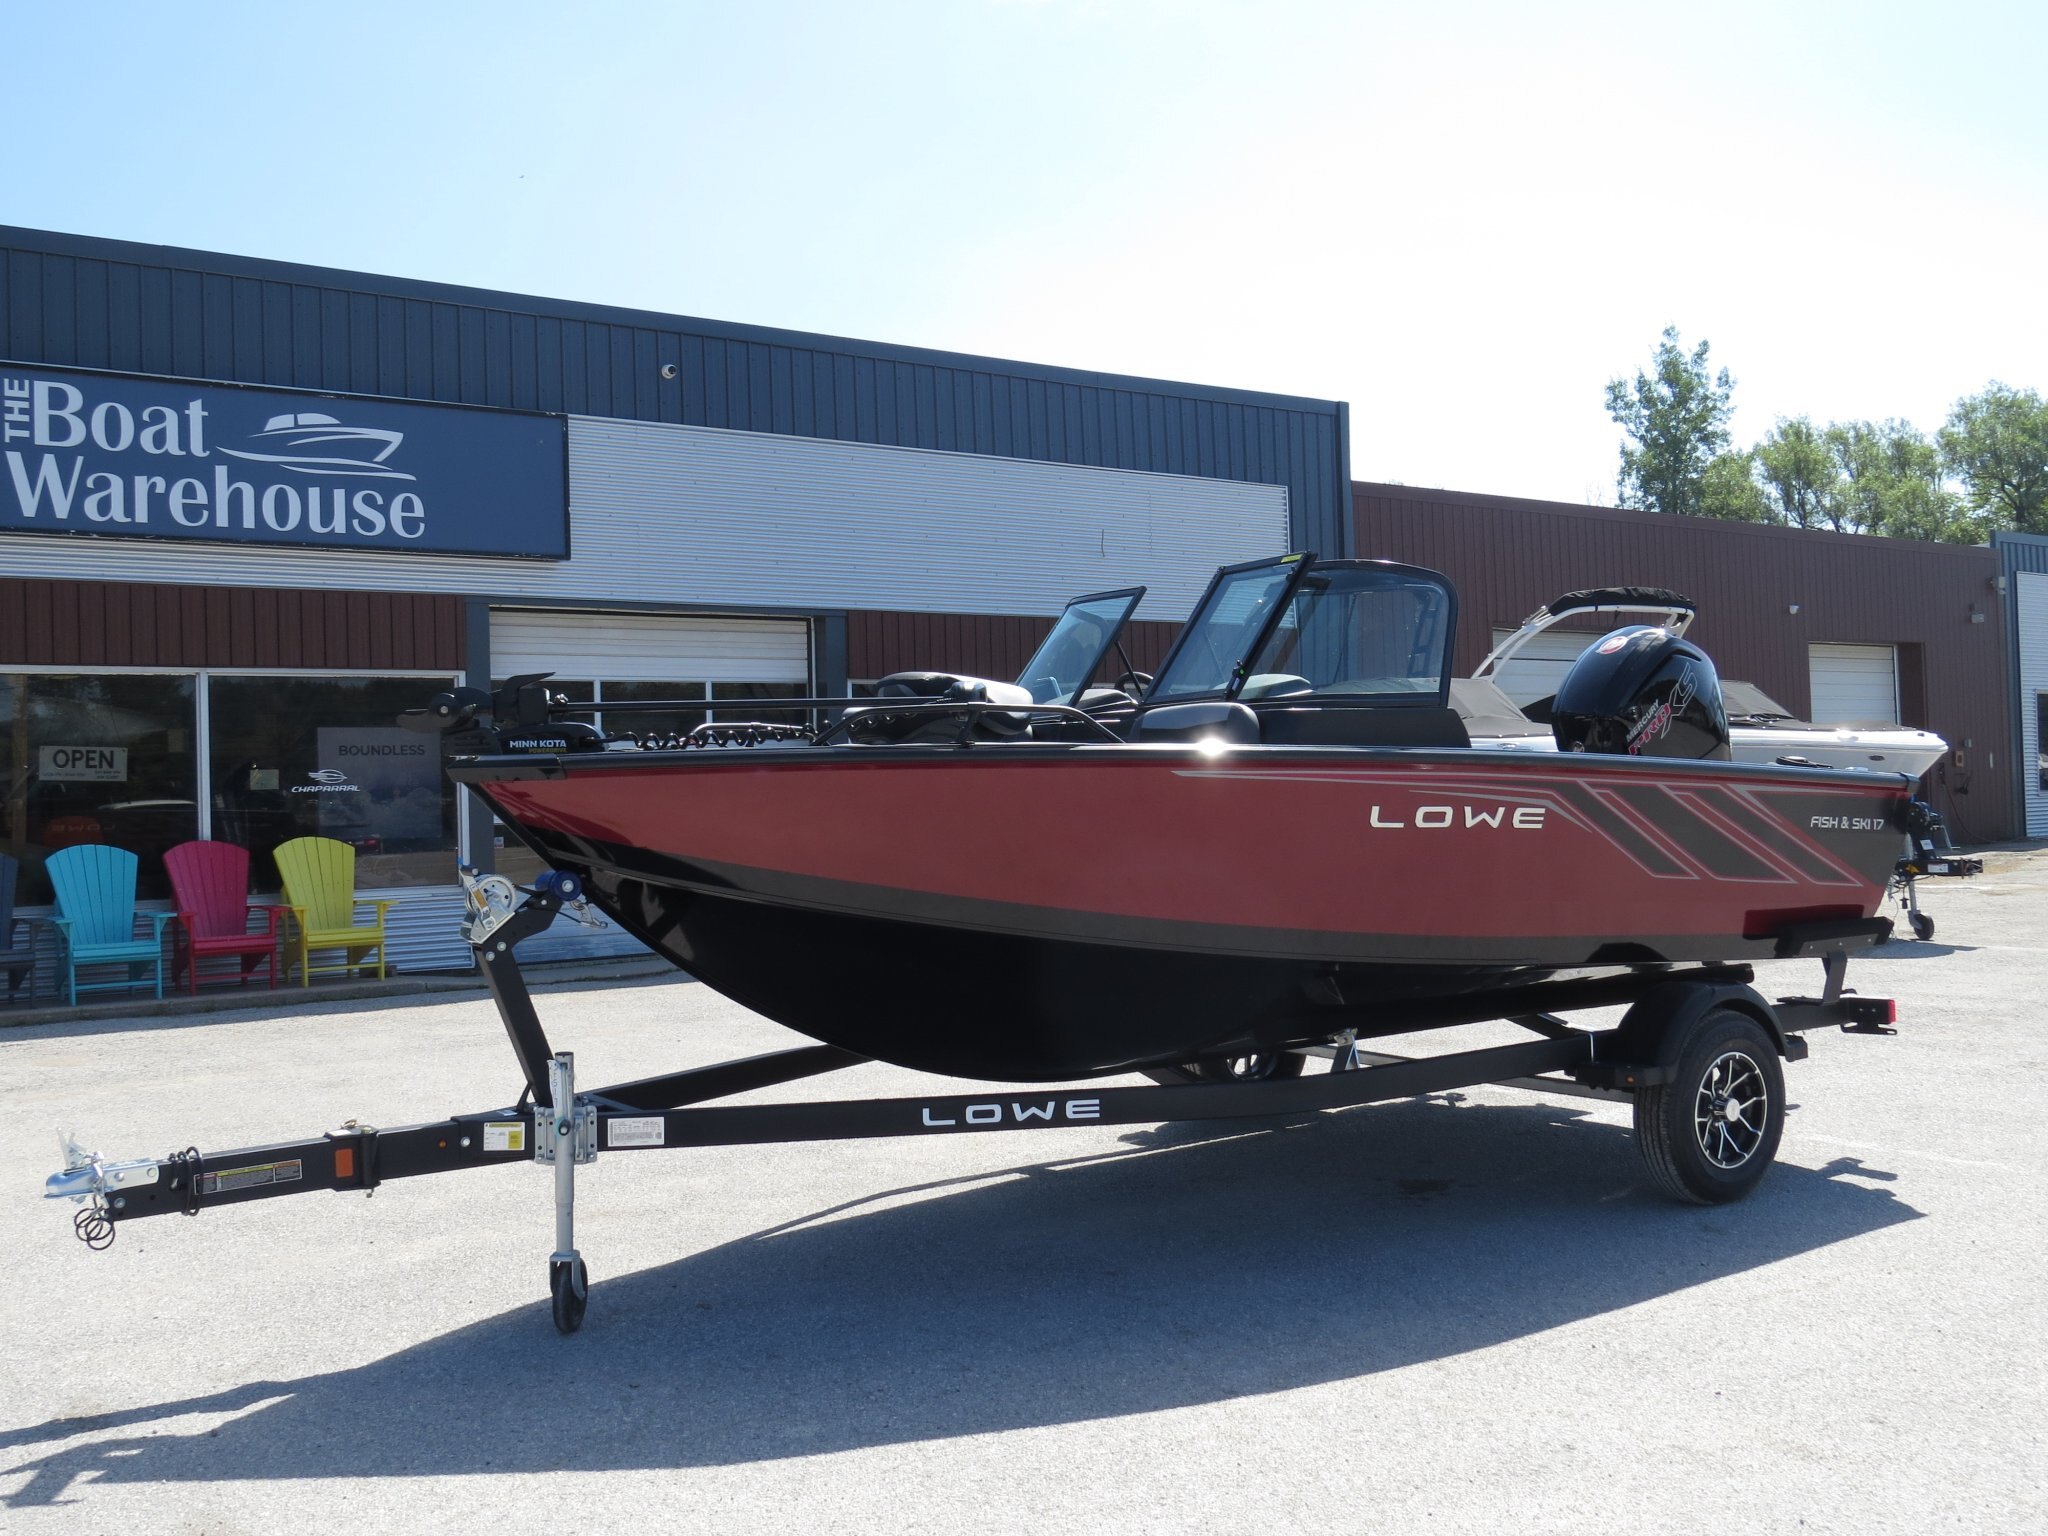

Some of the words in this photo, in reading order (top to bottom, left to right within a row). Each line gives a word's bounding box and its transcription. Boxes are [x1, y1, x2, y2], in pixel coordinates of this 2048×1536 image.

[3, 378, 30, 443] THE
[33, 380, 210, 458] Boat
[5, 450, 426, 539] Warehouse
[1626, 698, 1660, 743] MERCURY
[338, 744, 425, 756] BOUNDLESS
[509, 740, 538, 748] MINN
[539, 739, 567, 747] KOTA
[53, 749, 114, 769] OPEN
[291, 784, 361, 793] CHAPARRAL
[1369, 805, 1546, 829] LOWE
[1810, 816, 1838, 828] FISH
[1840, 816, 1850, 829] &
[1852, 818, 1871, 830] SKI
[1873, 819, 1884, 830] 17
[922, 1099, 1100, 1126] LOWE
